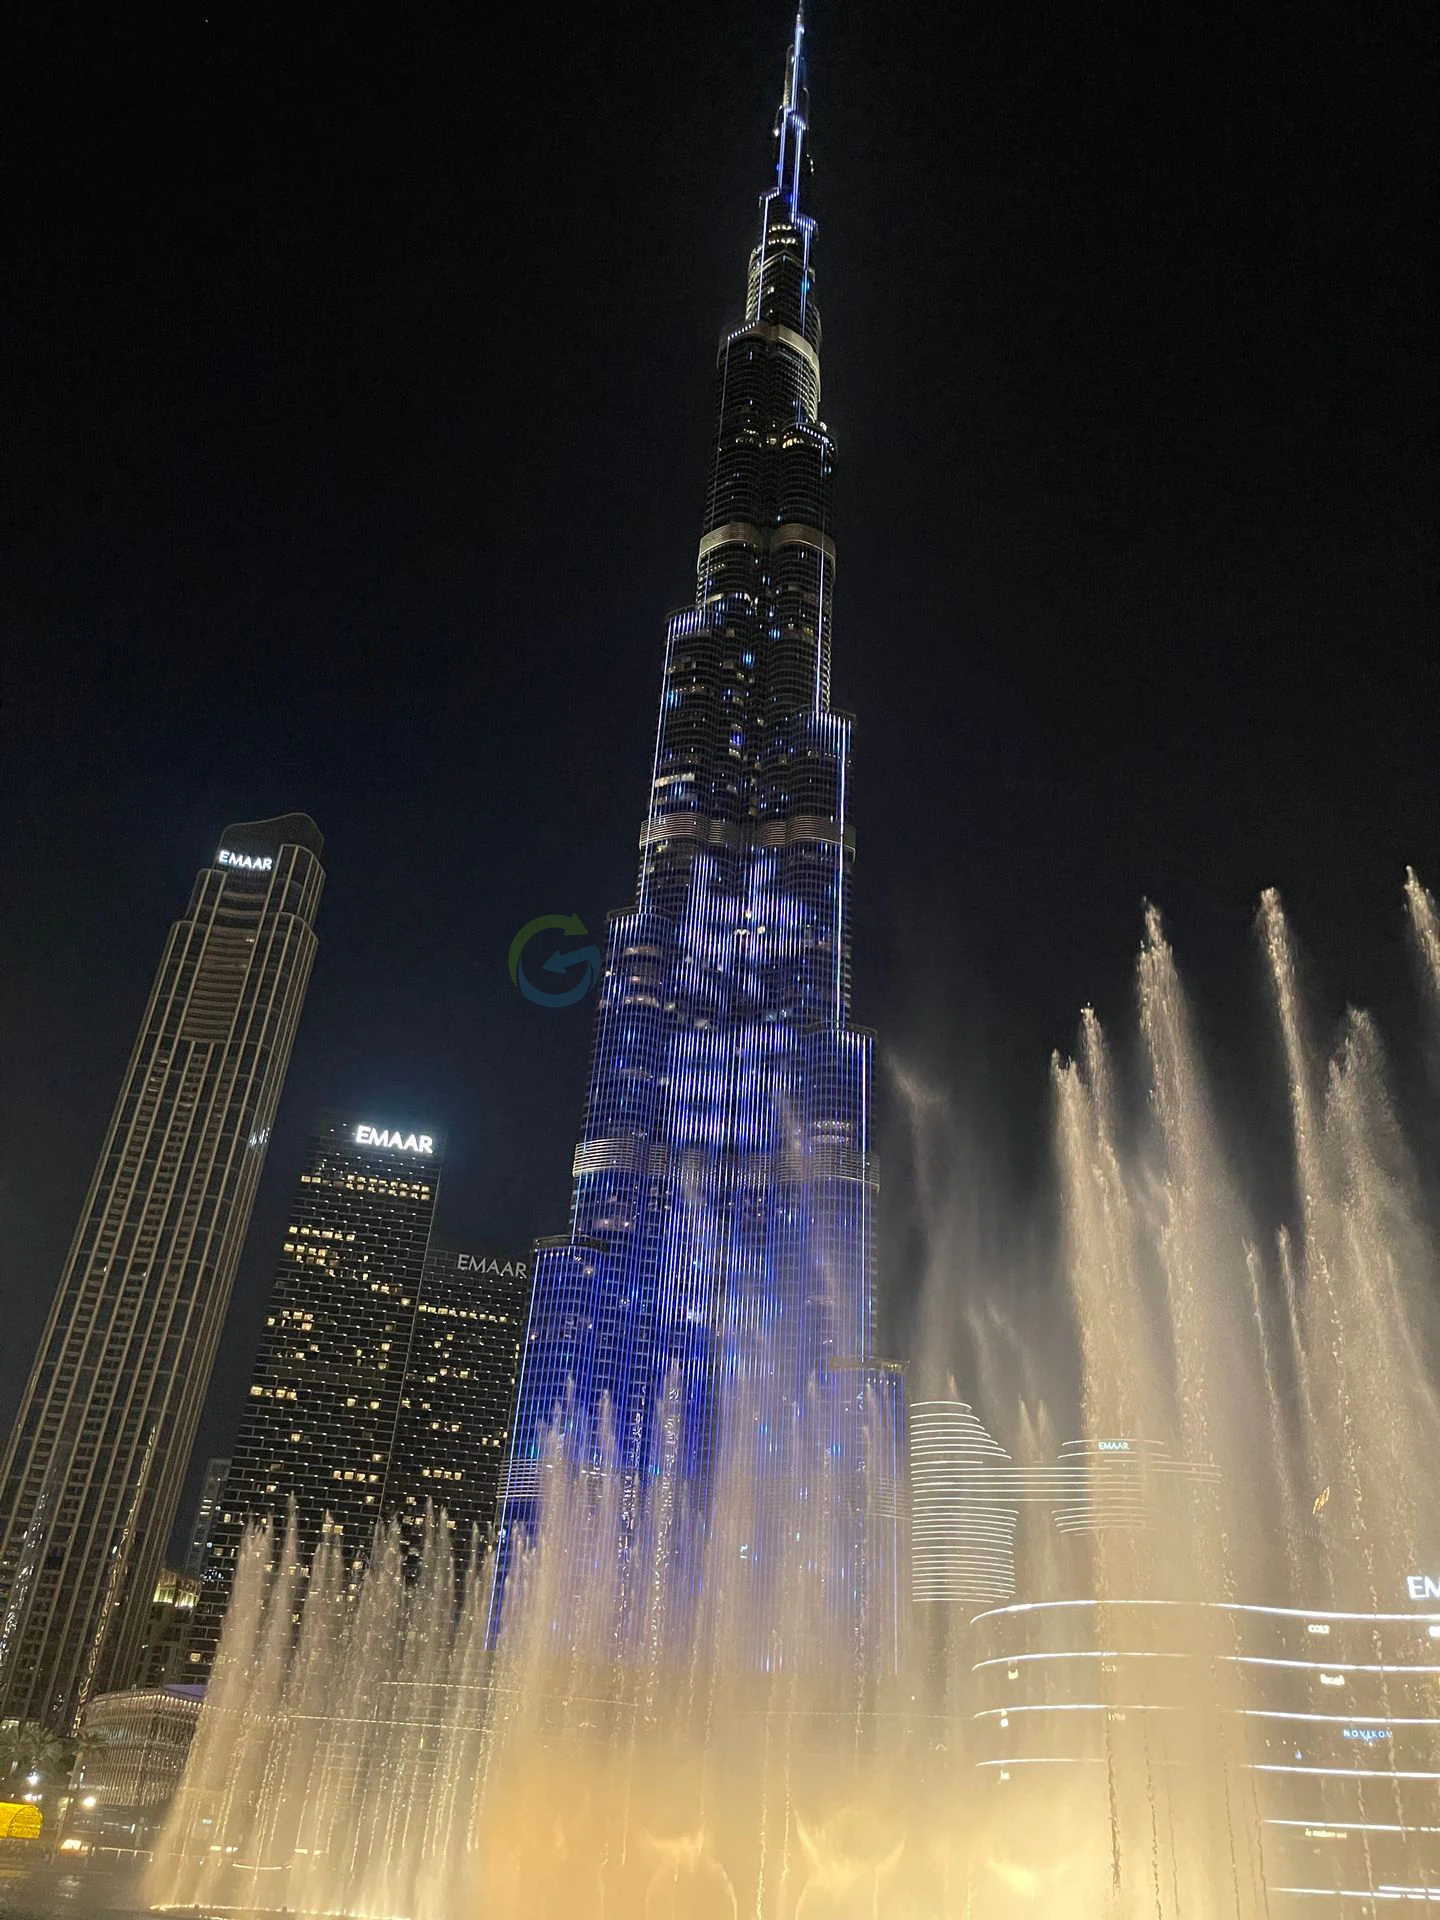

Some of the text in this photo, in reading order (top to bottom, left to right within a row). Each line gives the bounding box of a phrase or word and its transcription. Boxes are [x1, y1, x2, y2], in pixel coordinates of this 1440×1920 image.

[218, 850, 273, 871] EMAAR
[356, 1125, 433, 1154] EMAAR
[457, 1253, 528, 1279] EMAAR
[1098, 1441, 1130, 1450] EMAAR
